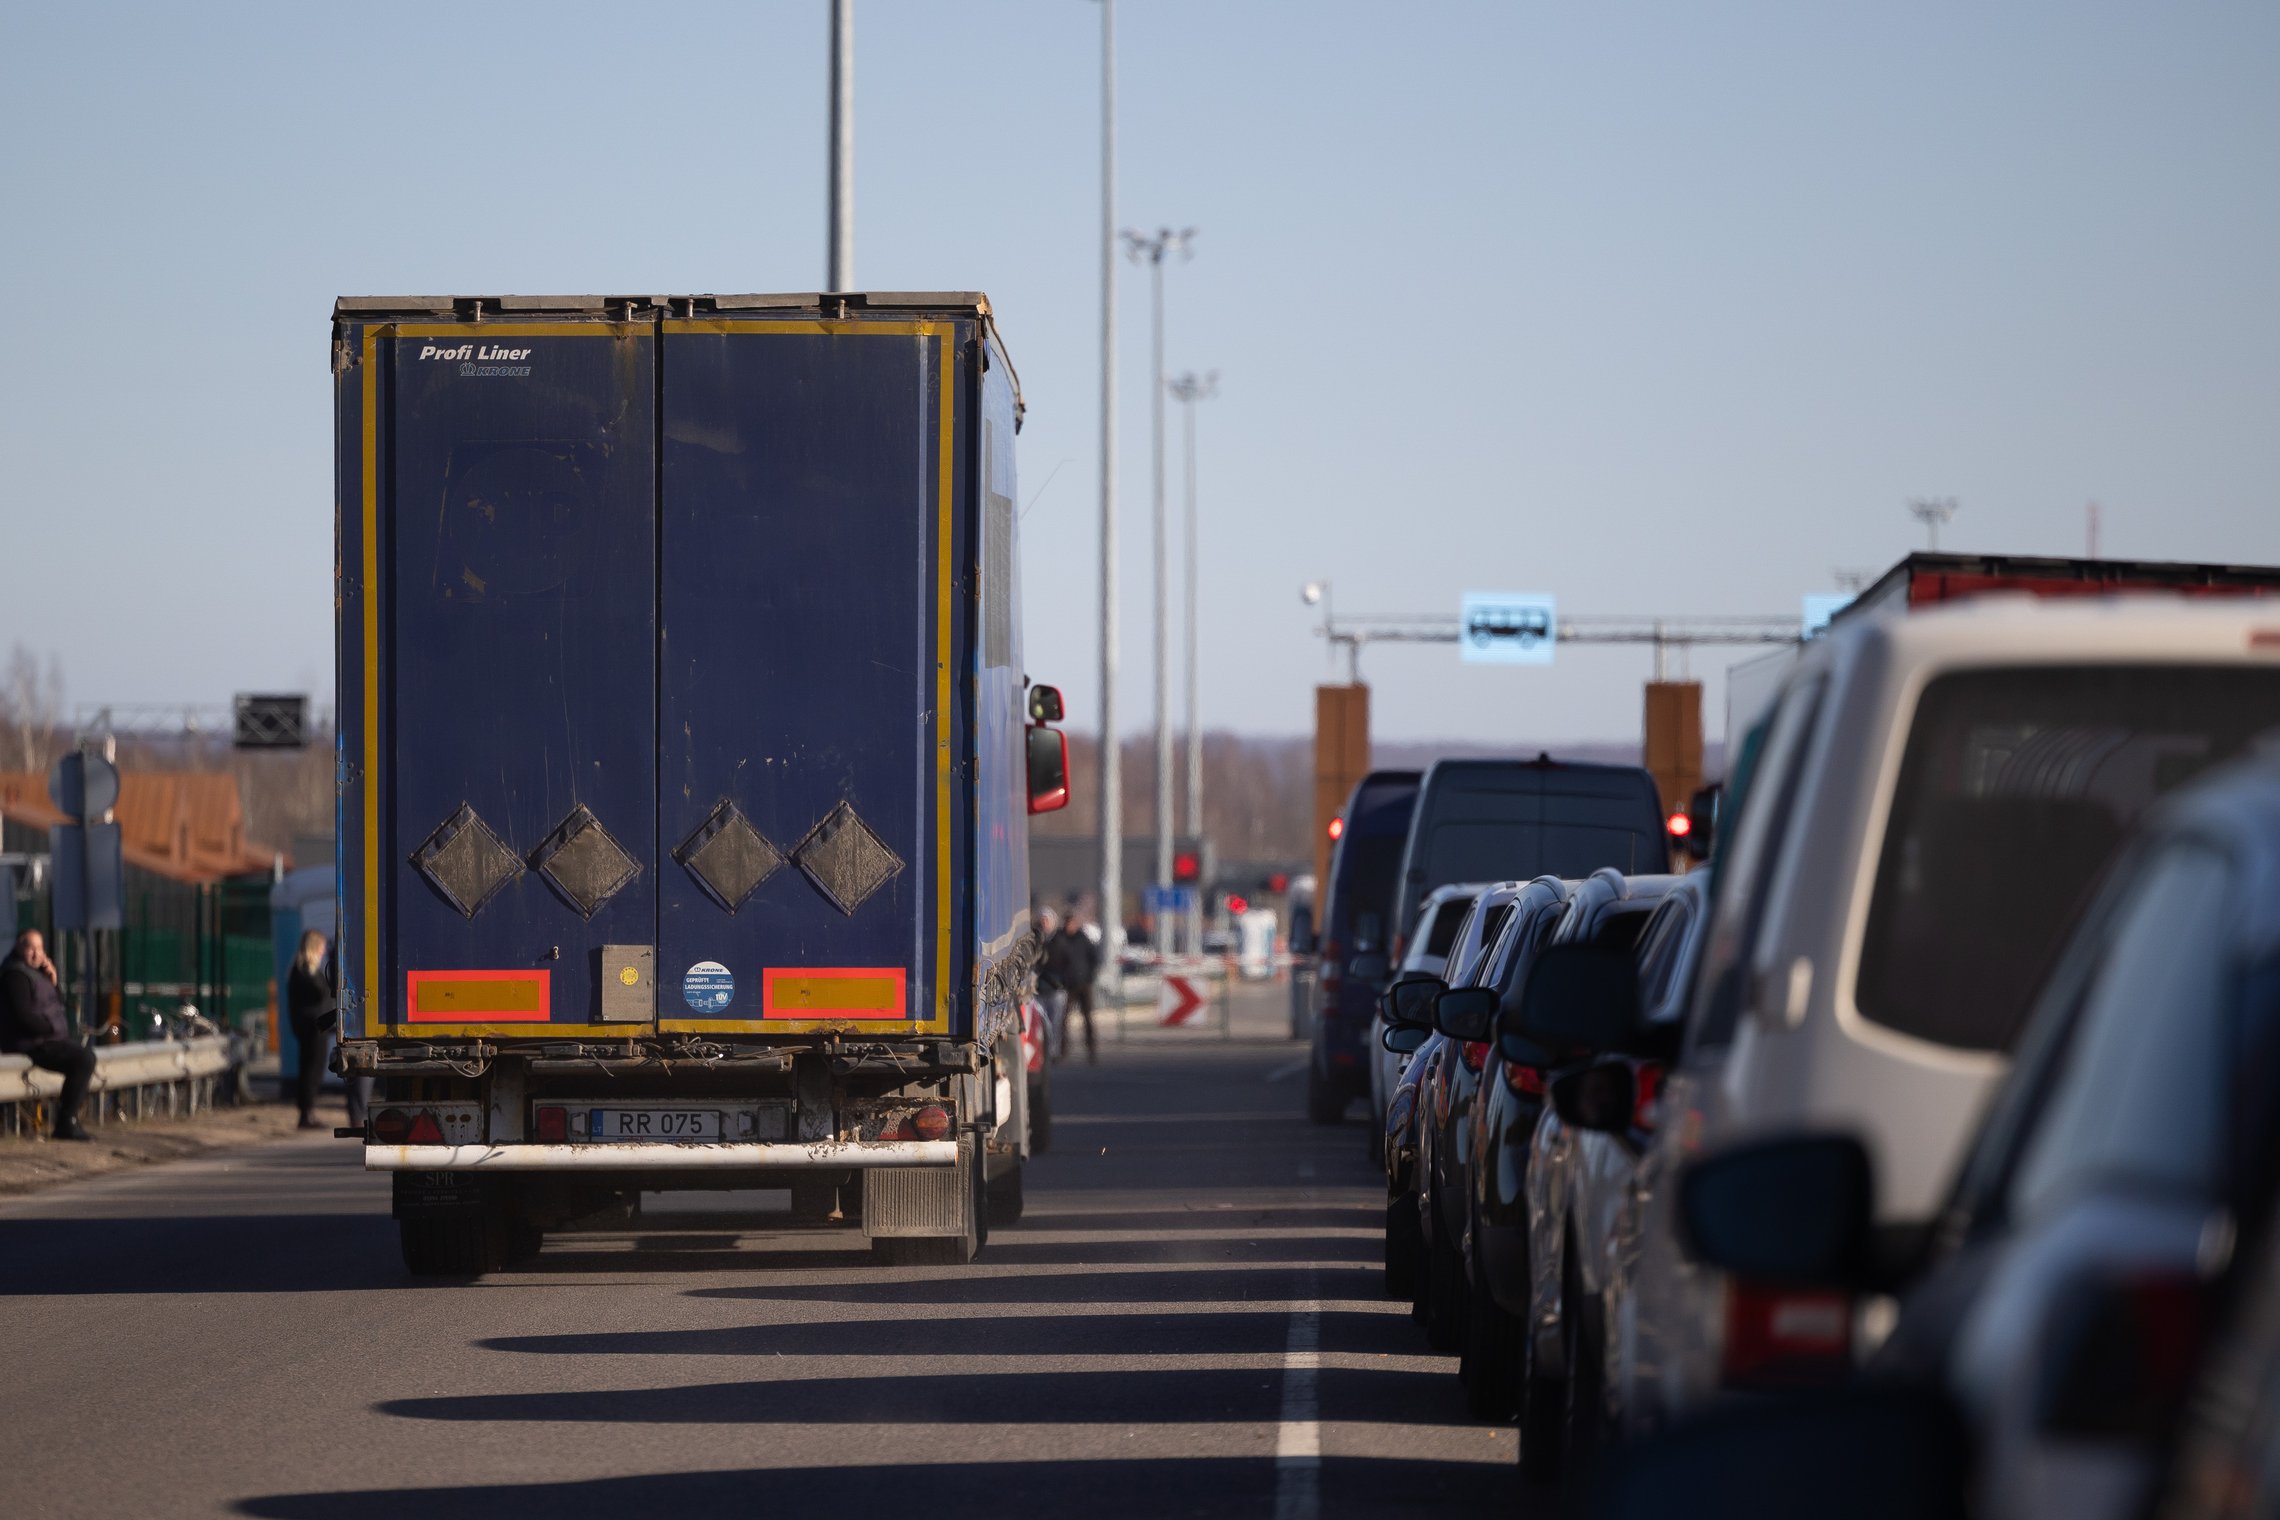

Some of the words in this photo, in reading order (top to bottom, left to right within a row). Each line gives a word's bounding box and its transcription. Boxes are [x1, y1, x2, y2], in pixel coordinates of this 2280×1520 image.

[419, 345, 473, 360] Profi
[478, 345, 532, 360] Liner
[476, 366, 531, 376] KRONE
[619, 1113, 651, 1134] RR
[661, 1113, 703, 1134] 075
[425, 1171, 455, 1186] SPR
